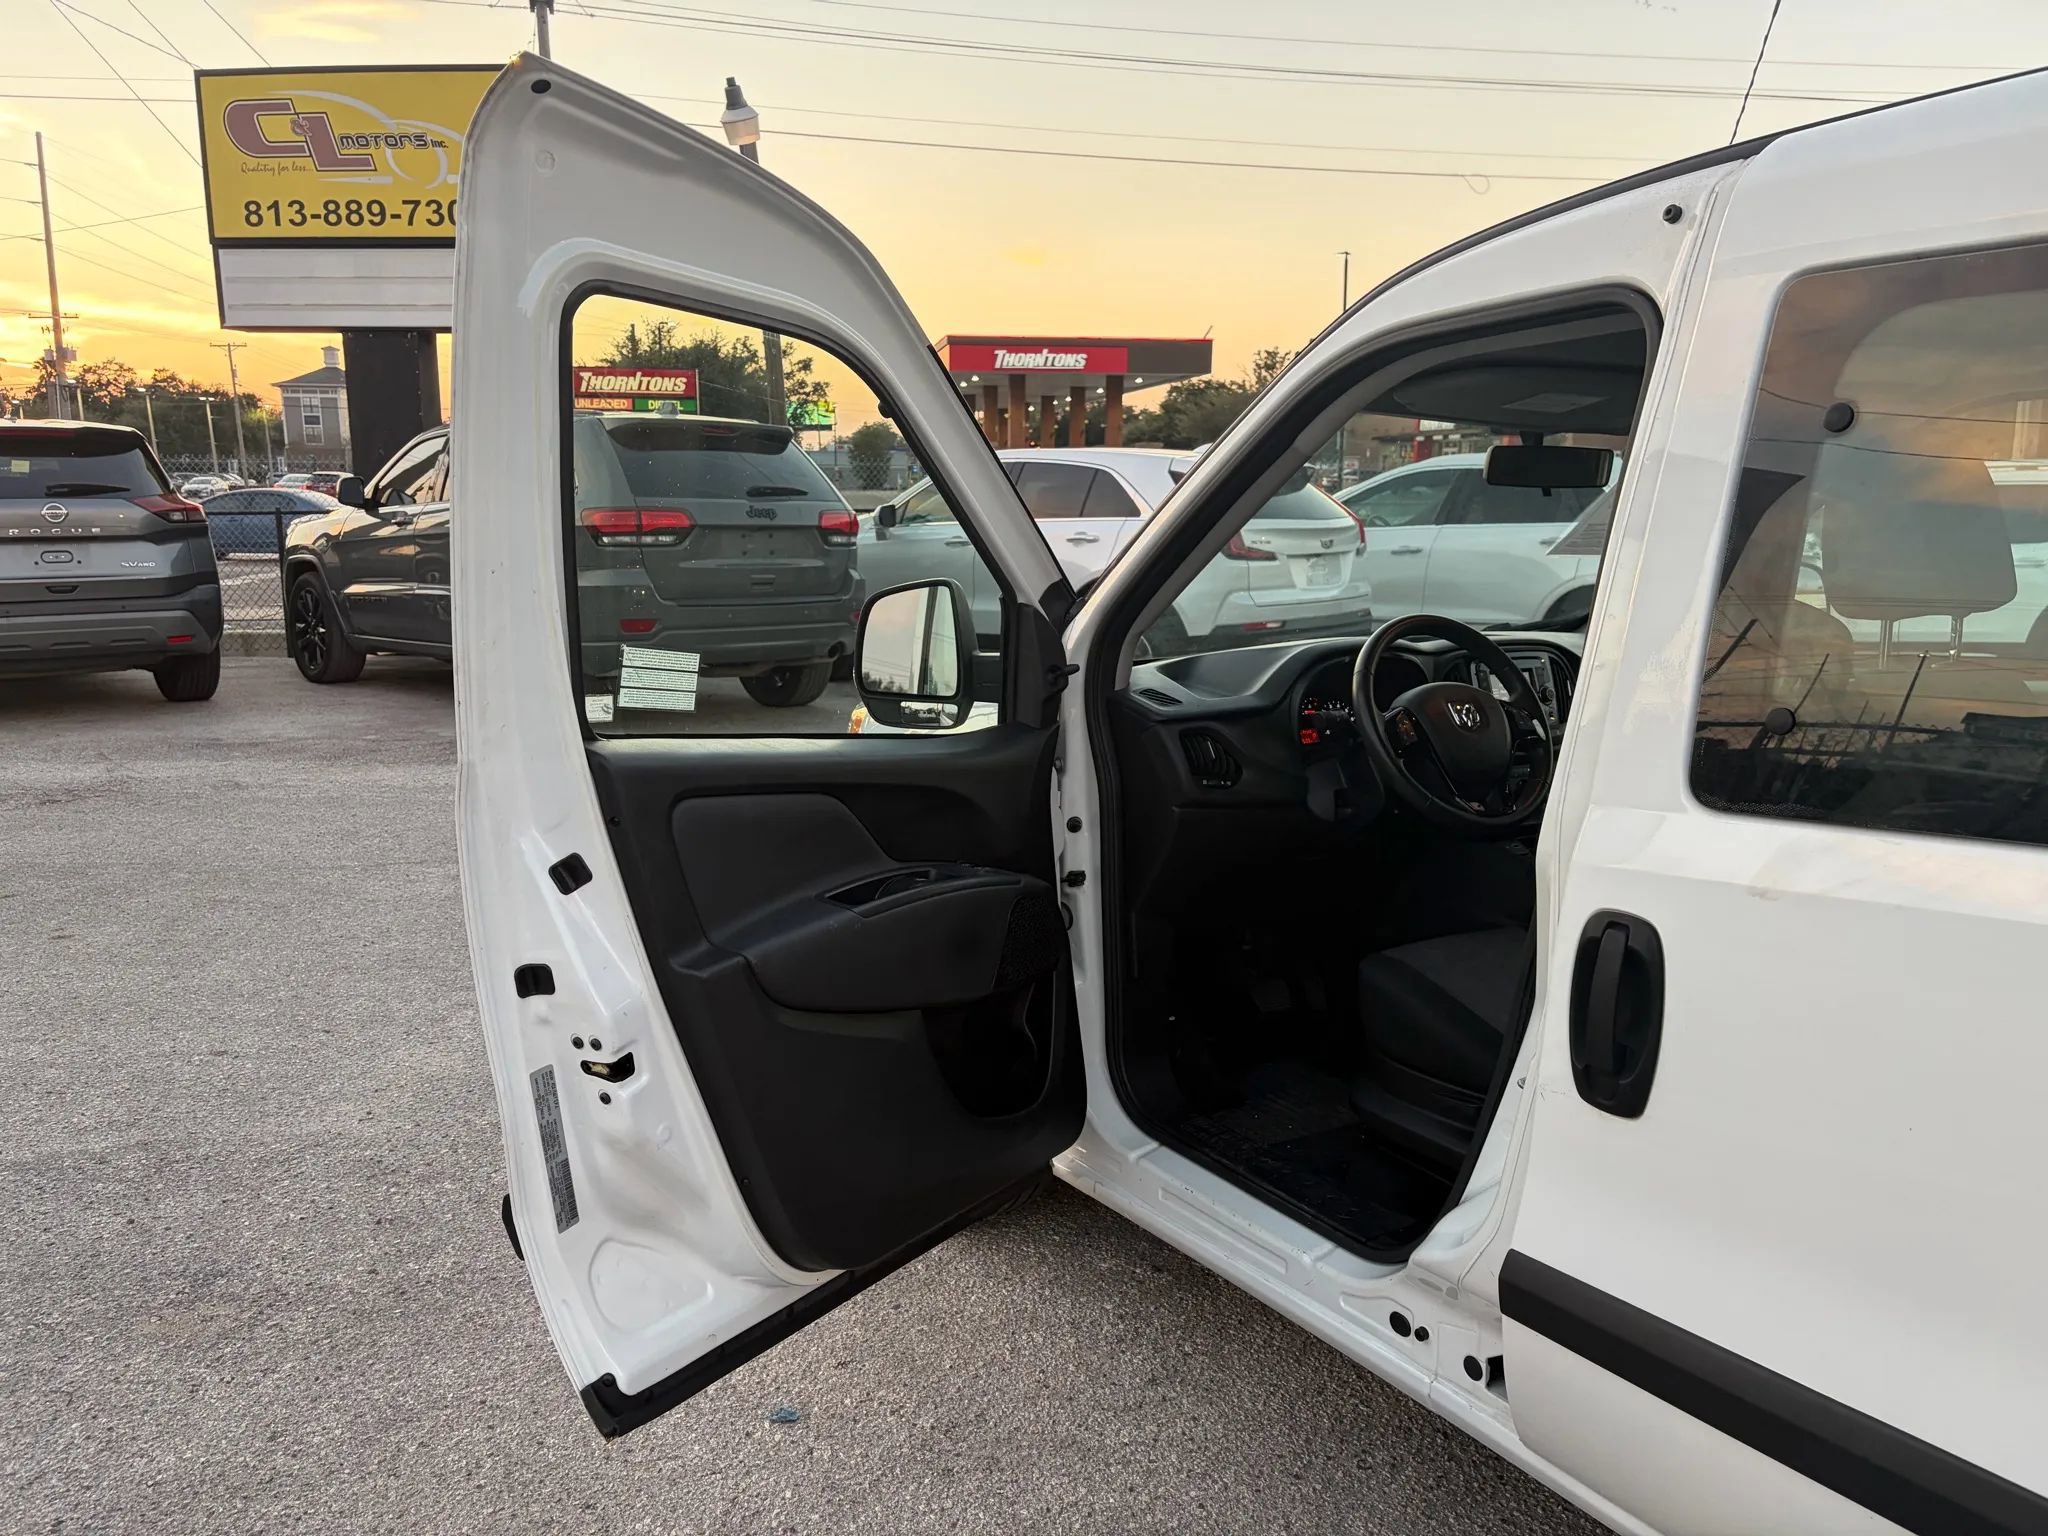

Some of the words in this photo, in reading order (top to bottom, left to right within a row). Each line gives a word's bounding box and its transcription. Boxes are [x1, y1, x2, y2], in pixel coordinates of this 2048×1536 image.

[430, 138, 449, 149] Inc.
[278, 161, 289, 175] for
[993, 348, 1088, 369] THORNTONS
[579, 371, 688, 394] THORNTONS
[575, 399, 628, 409] UNLEADED
[745, 504, 777, 521] Jeep
[9, 527, 101, 536] ROGUE
